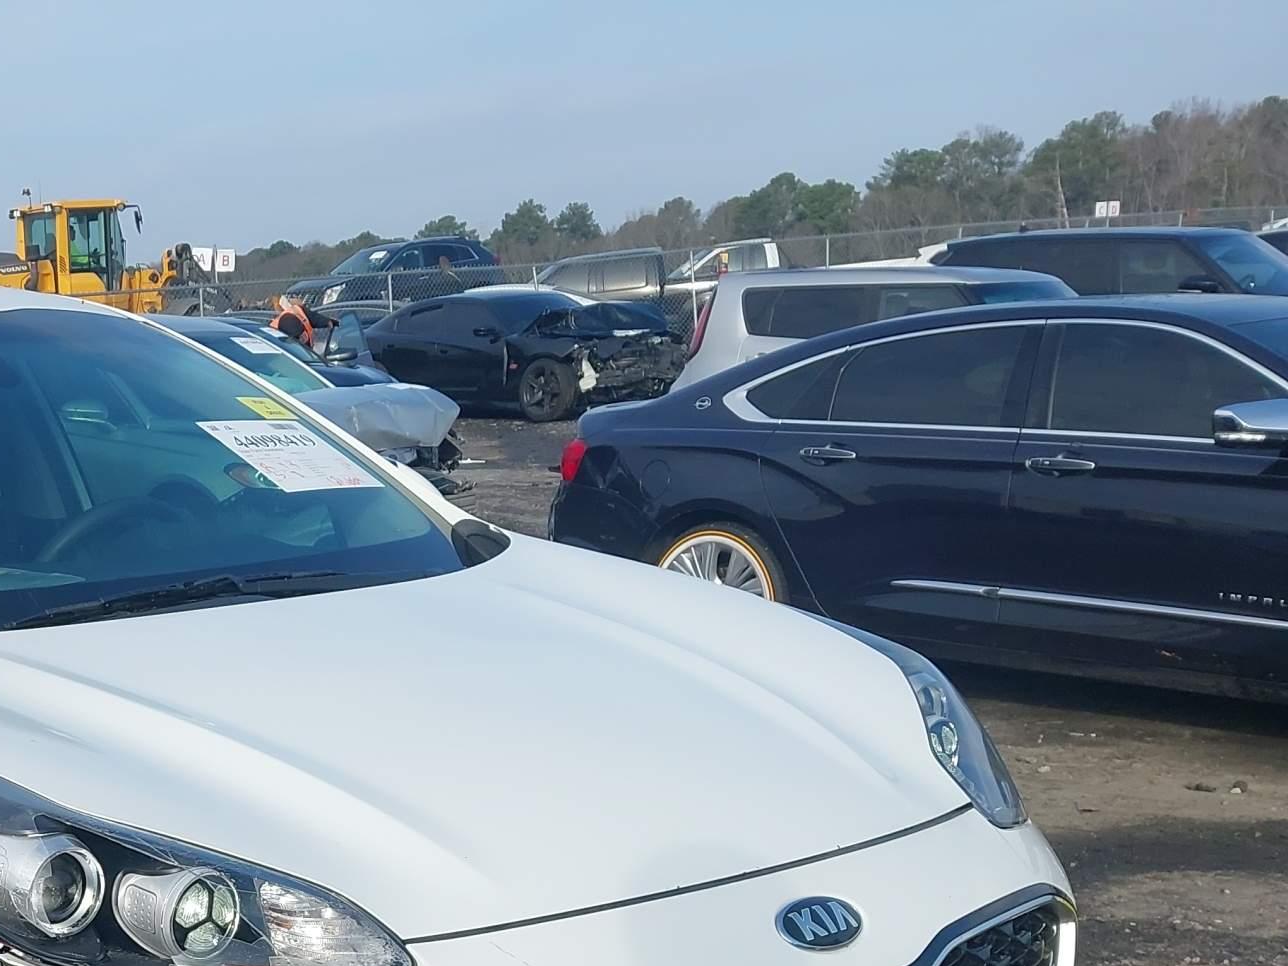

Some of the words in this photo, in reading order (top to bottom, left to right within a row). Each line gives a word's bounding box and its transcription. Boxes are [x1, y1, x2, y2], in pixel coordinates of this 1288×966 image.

[222, 255, 230, 267] B
[0, 265, 28, 273] VOLVO
[233, 434, 317, 449] 44098419
[787, 901, 859, 941] KIA
